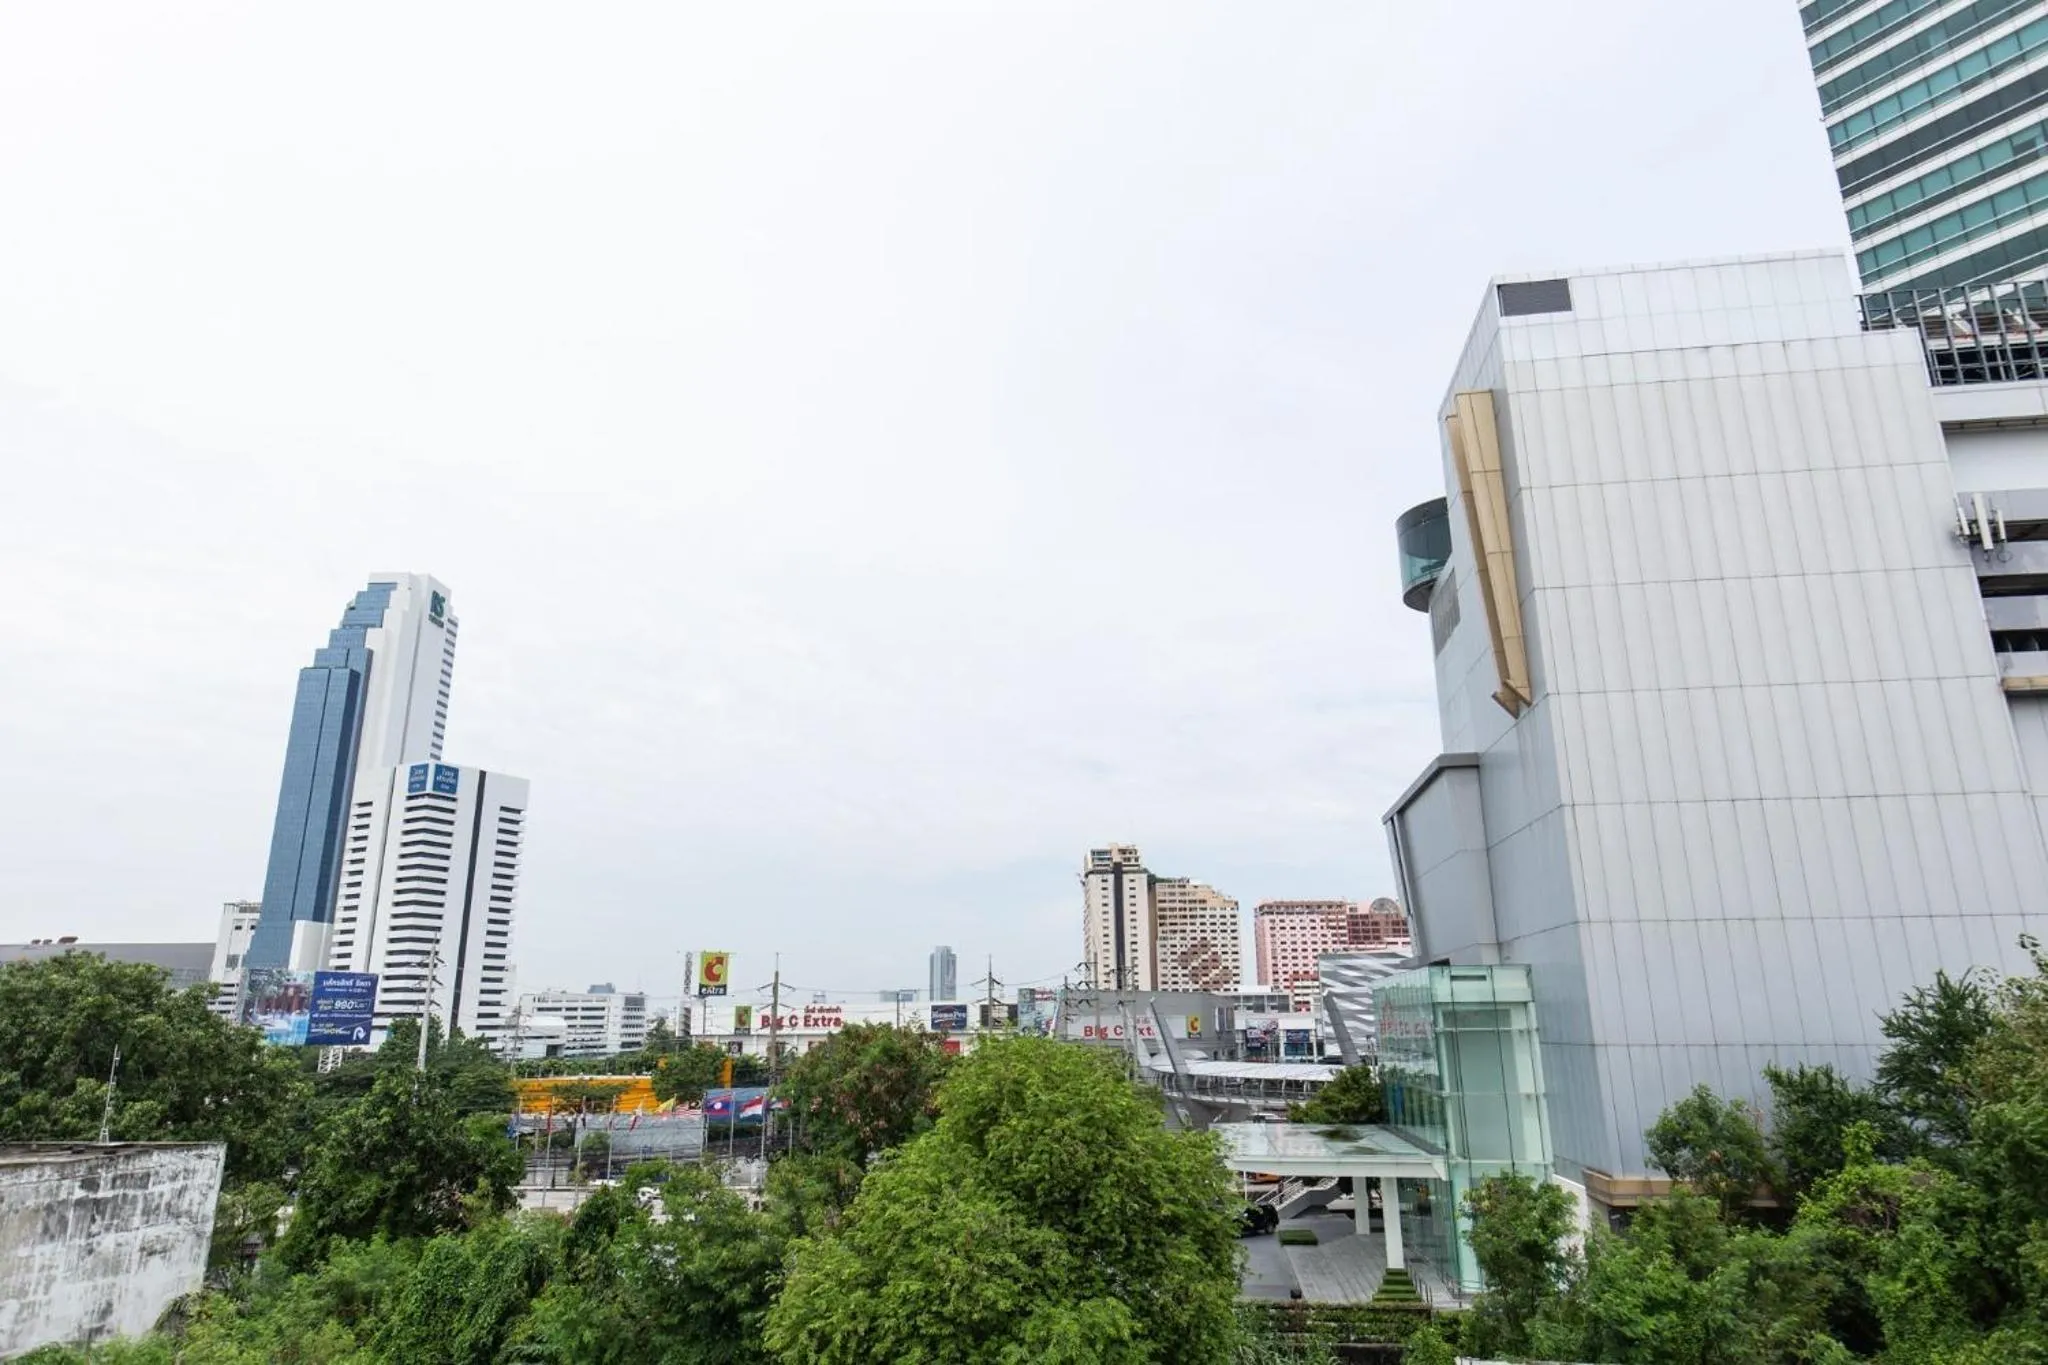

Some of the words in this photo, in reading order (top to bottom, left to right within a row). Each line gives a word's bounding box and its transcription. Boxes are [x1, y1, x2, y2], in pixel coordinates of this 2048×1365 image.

[761, 1015, 784, 1030] Bg
[789, 1015, 798, 1027] C
[803, 1014, 842, 1028] Extra
[1114, 1025, 1124, 1036] C
